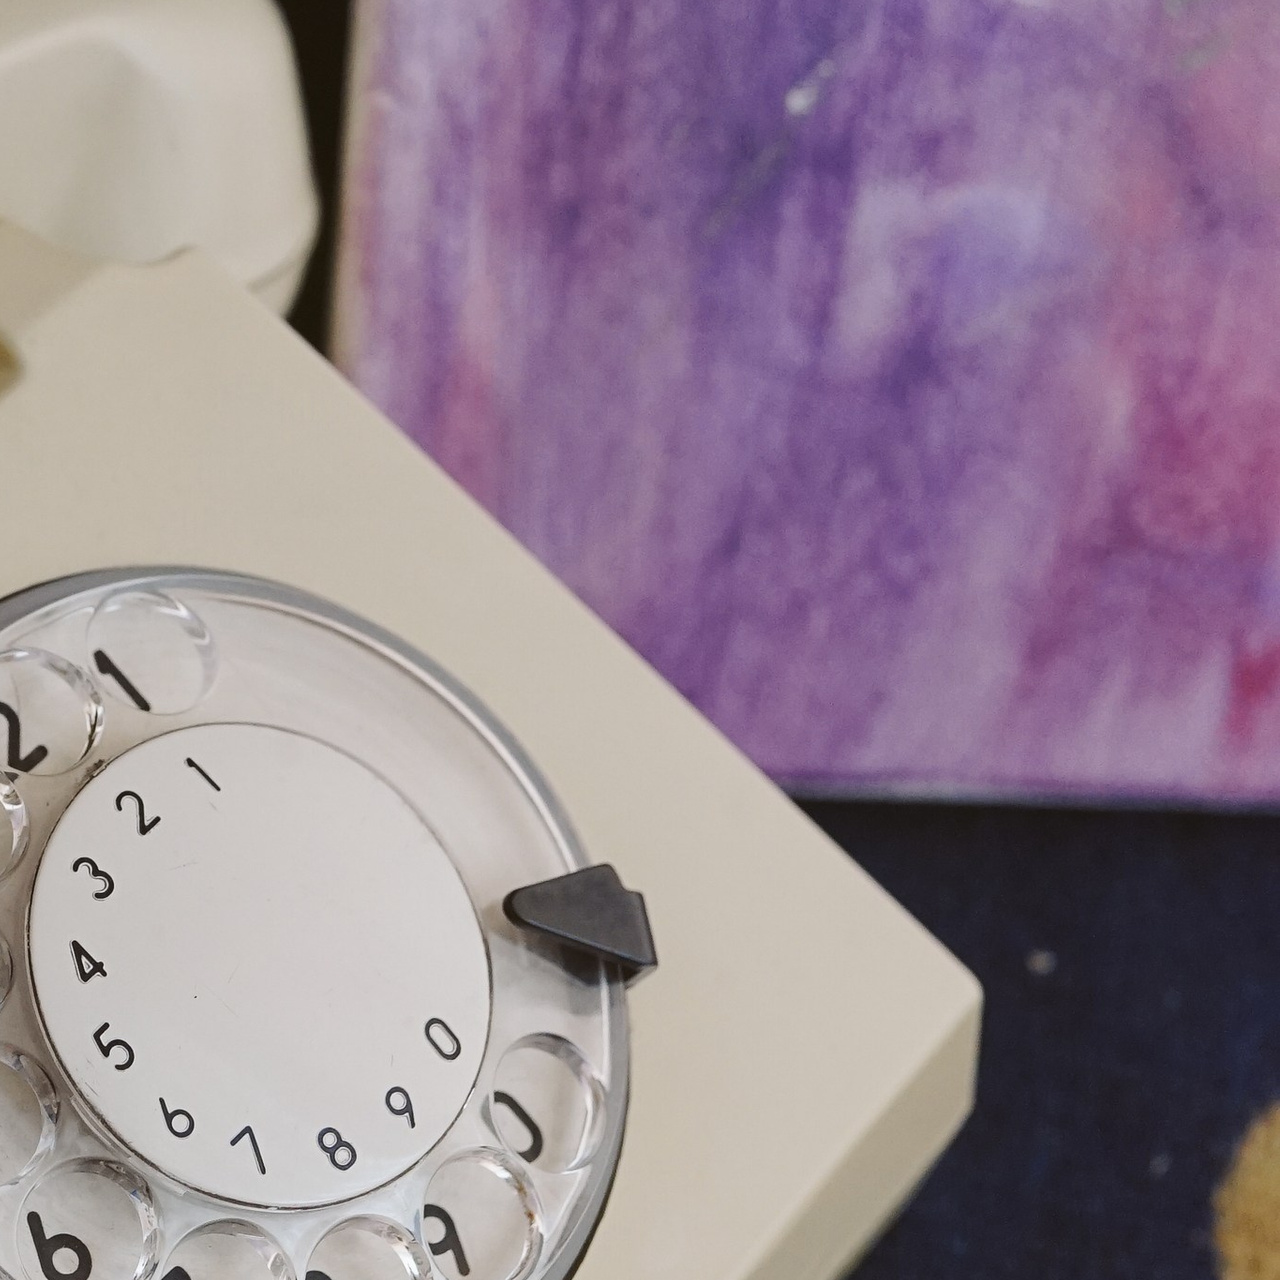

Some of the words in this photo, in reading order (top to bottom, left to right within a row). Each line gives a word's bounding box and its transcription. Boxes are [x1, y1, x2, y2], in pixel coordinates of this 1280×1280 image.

[93, 649, 152, 713] 1
[184, 757, 221, 793] 1
[114, 790, 162, 836] 2
[72, 856, 115, 900] 3
[71, 939, 108, 983] 4
[92, 1021, 136, 1071] 5
[424, 1017, 463, 1062] 0
[158, 1097, 196, 1139] 6
[385, 1086, 416, 1129] 9
[229, 1125, 267, 1175] 7
[317, 1127, 357, 1171] 8
[415, 1203, 471, 1277] 9
